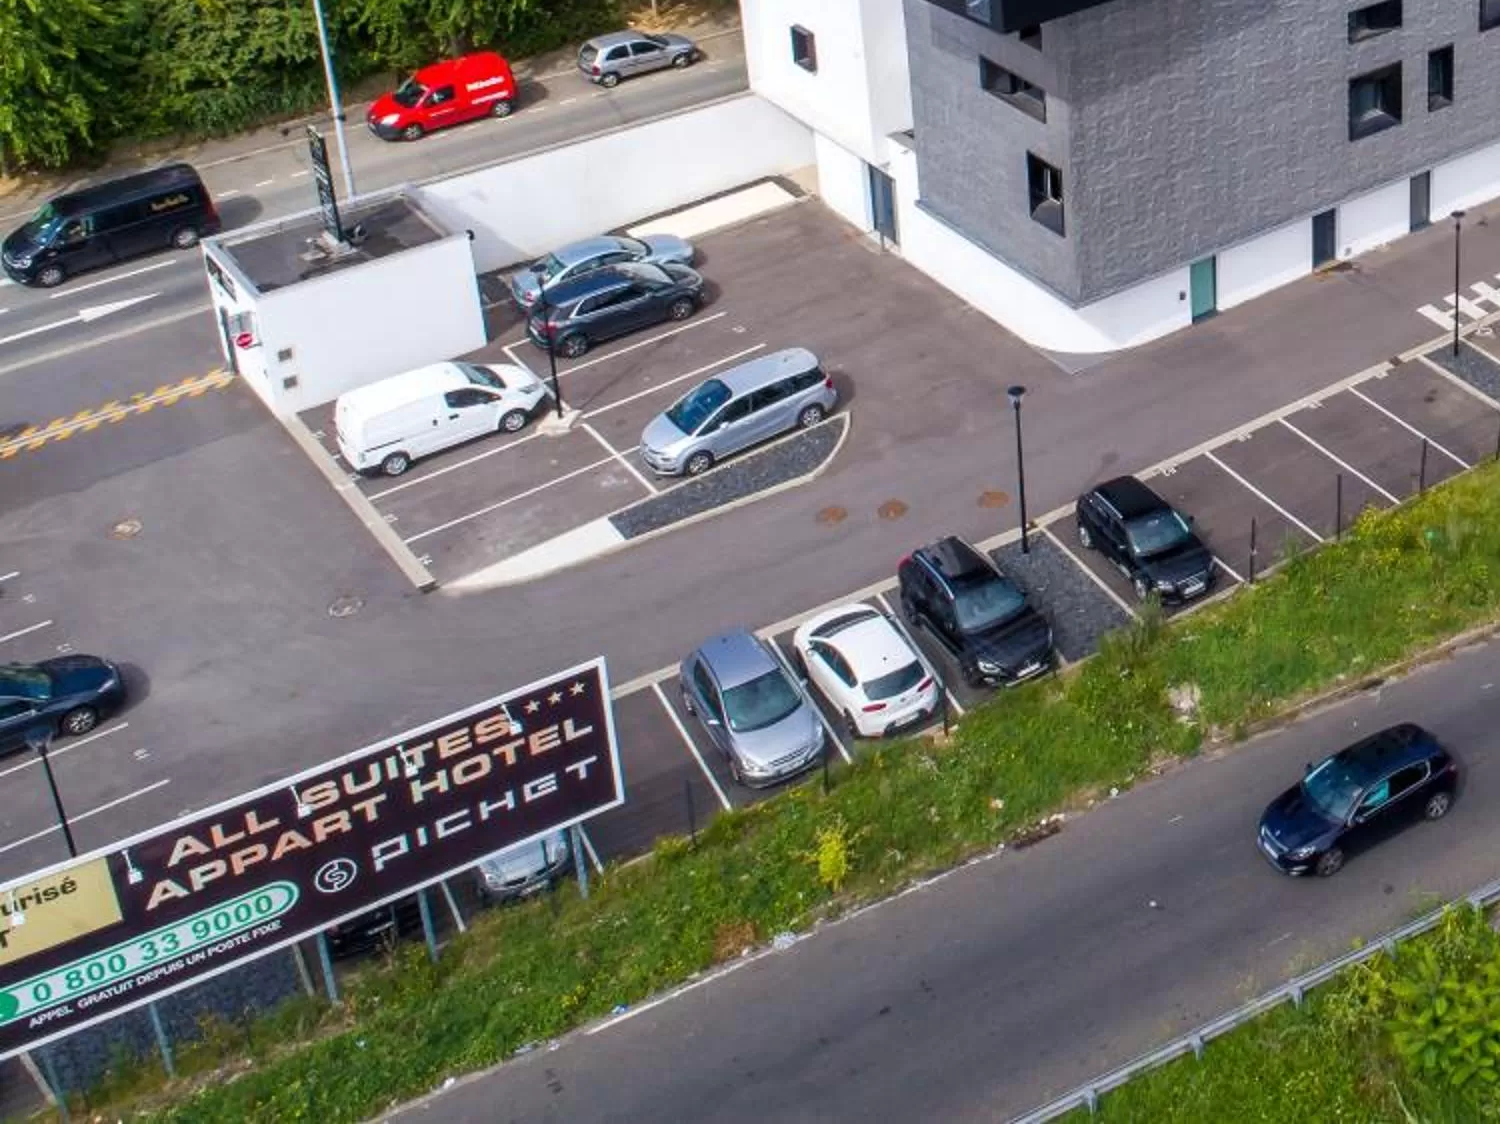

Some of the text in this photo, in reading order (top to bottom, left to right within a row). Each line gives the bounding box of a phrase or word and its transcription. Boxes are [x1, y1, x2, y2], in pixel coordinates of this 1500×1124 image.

[146, 718, 593, 911] APPART HOTEL
[167, 712, 511, 868] ALL SUITES
[371, 756, 598, 872] PICHET
[28, 919, 283, 1029] APPEL GRATUIT DEPUIS UN POSTE FIXE
[32, 894, 273, 1002] 0 800 33 9000
